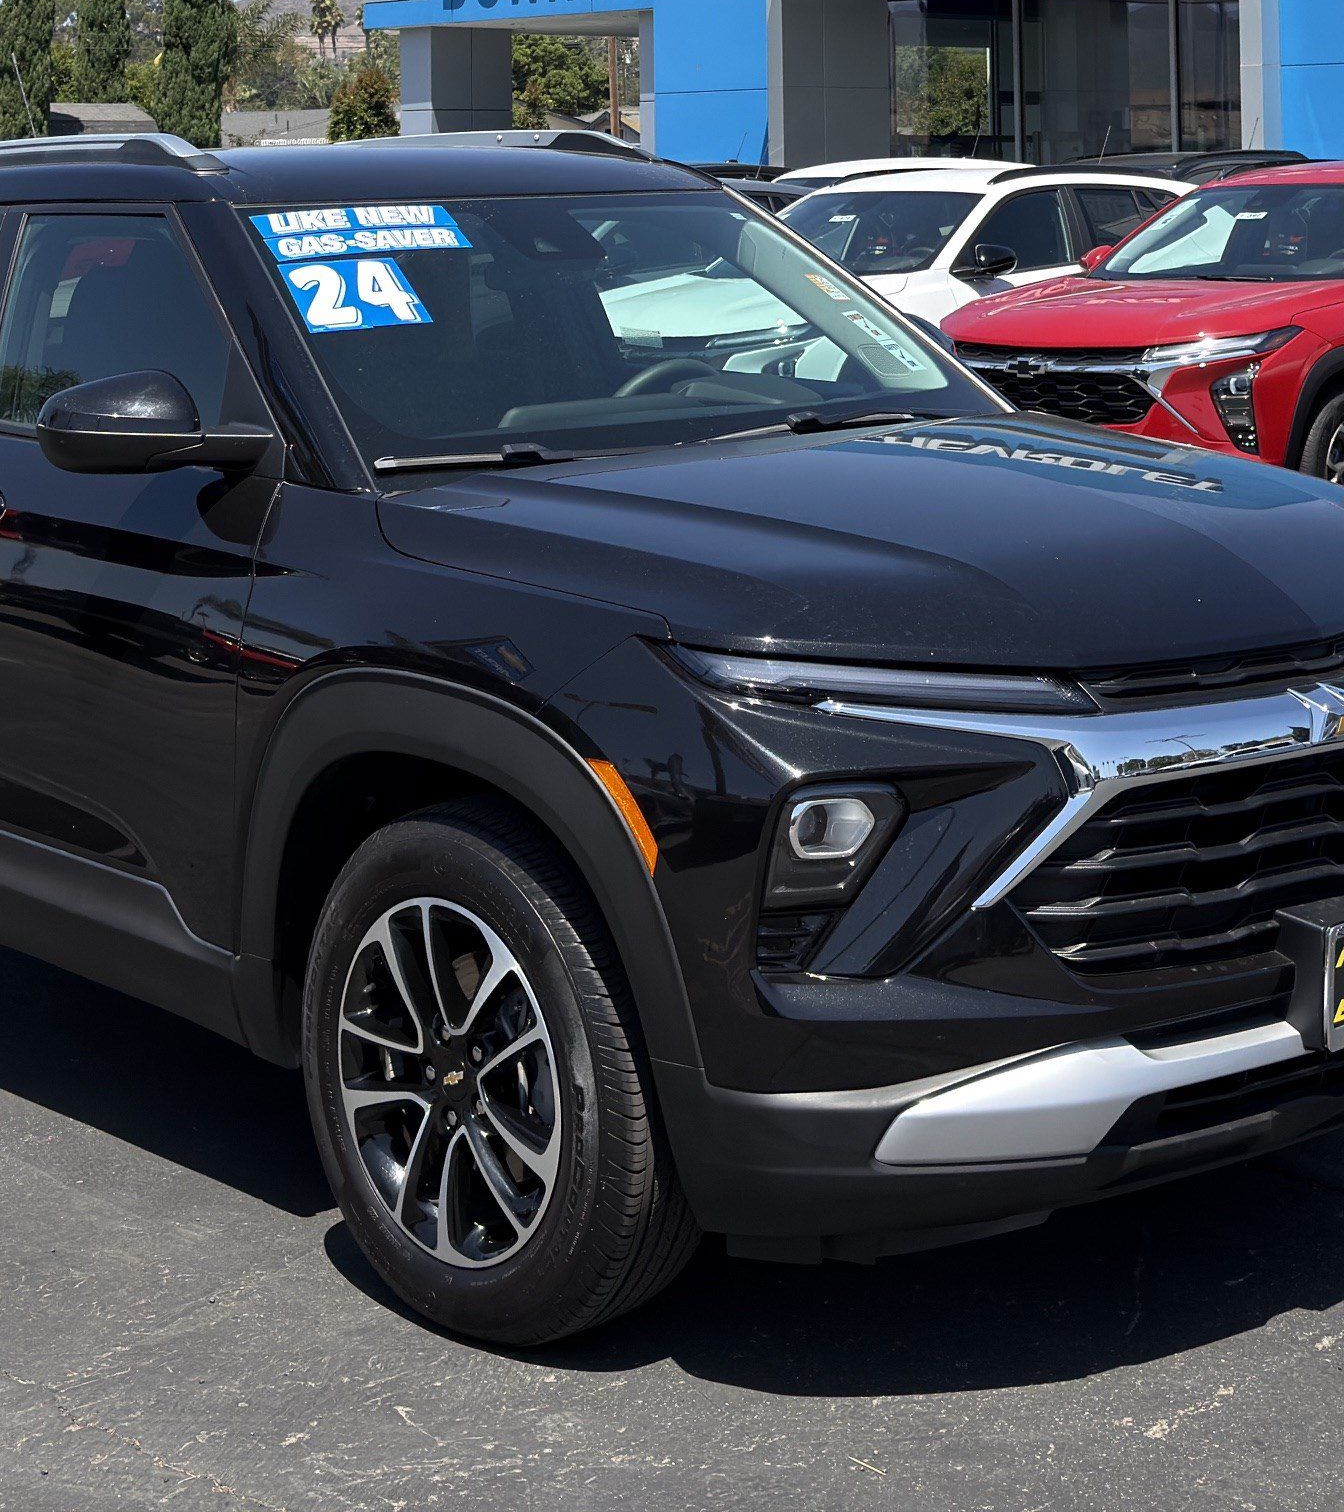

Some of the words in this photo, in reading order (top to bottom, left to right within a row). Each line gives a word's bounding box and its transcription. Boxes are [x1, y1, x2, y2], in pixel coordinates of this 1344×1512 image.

[267, 208, 352, 233] LIKE
[353, 205, 436, 227] NEW
[277, 228, 460, 257] GAS-SAVER
[288, 260, 423, 328] 24
